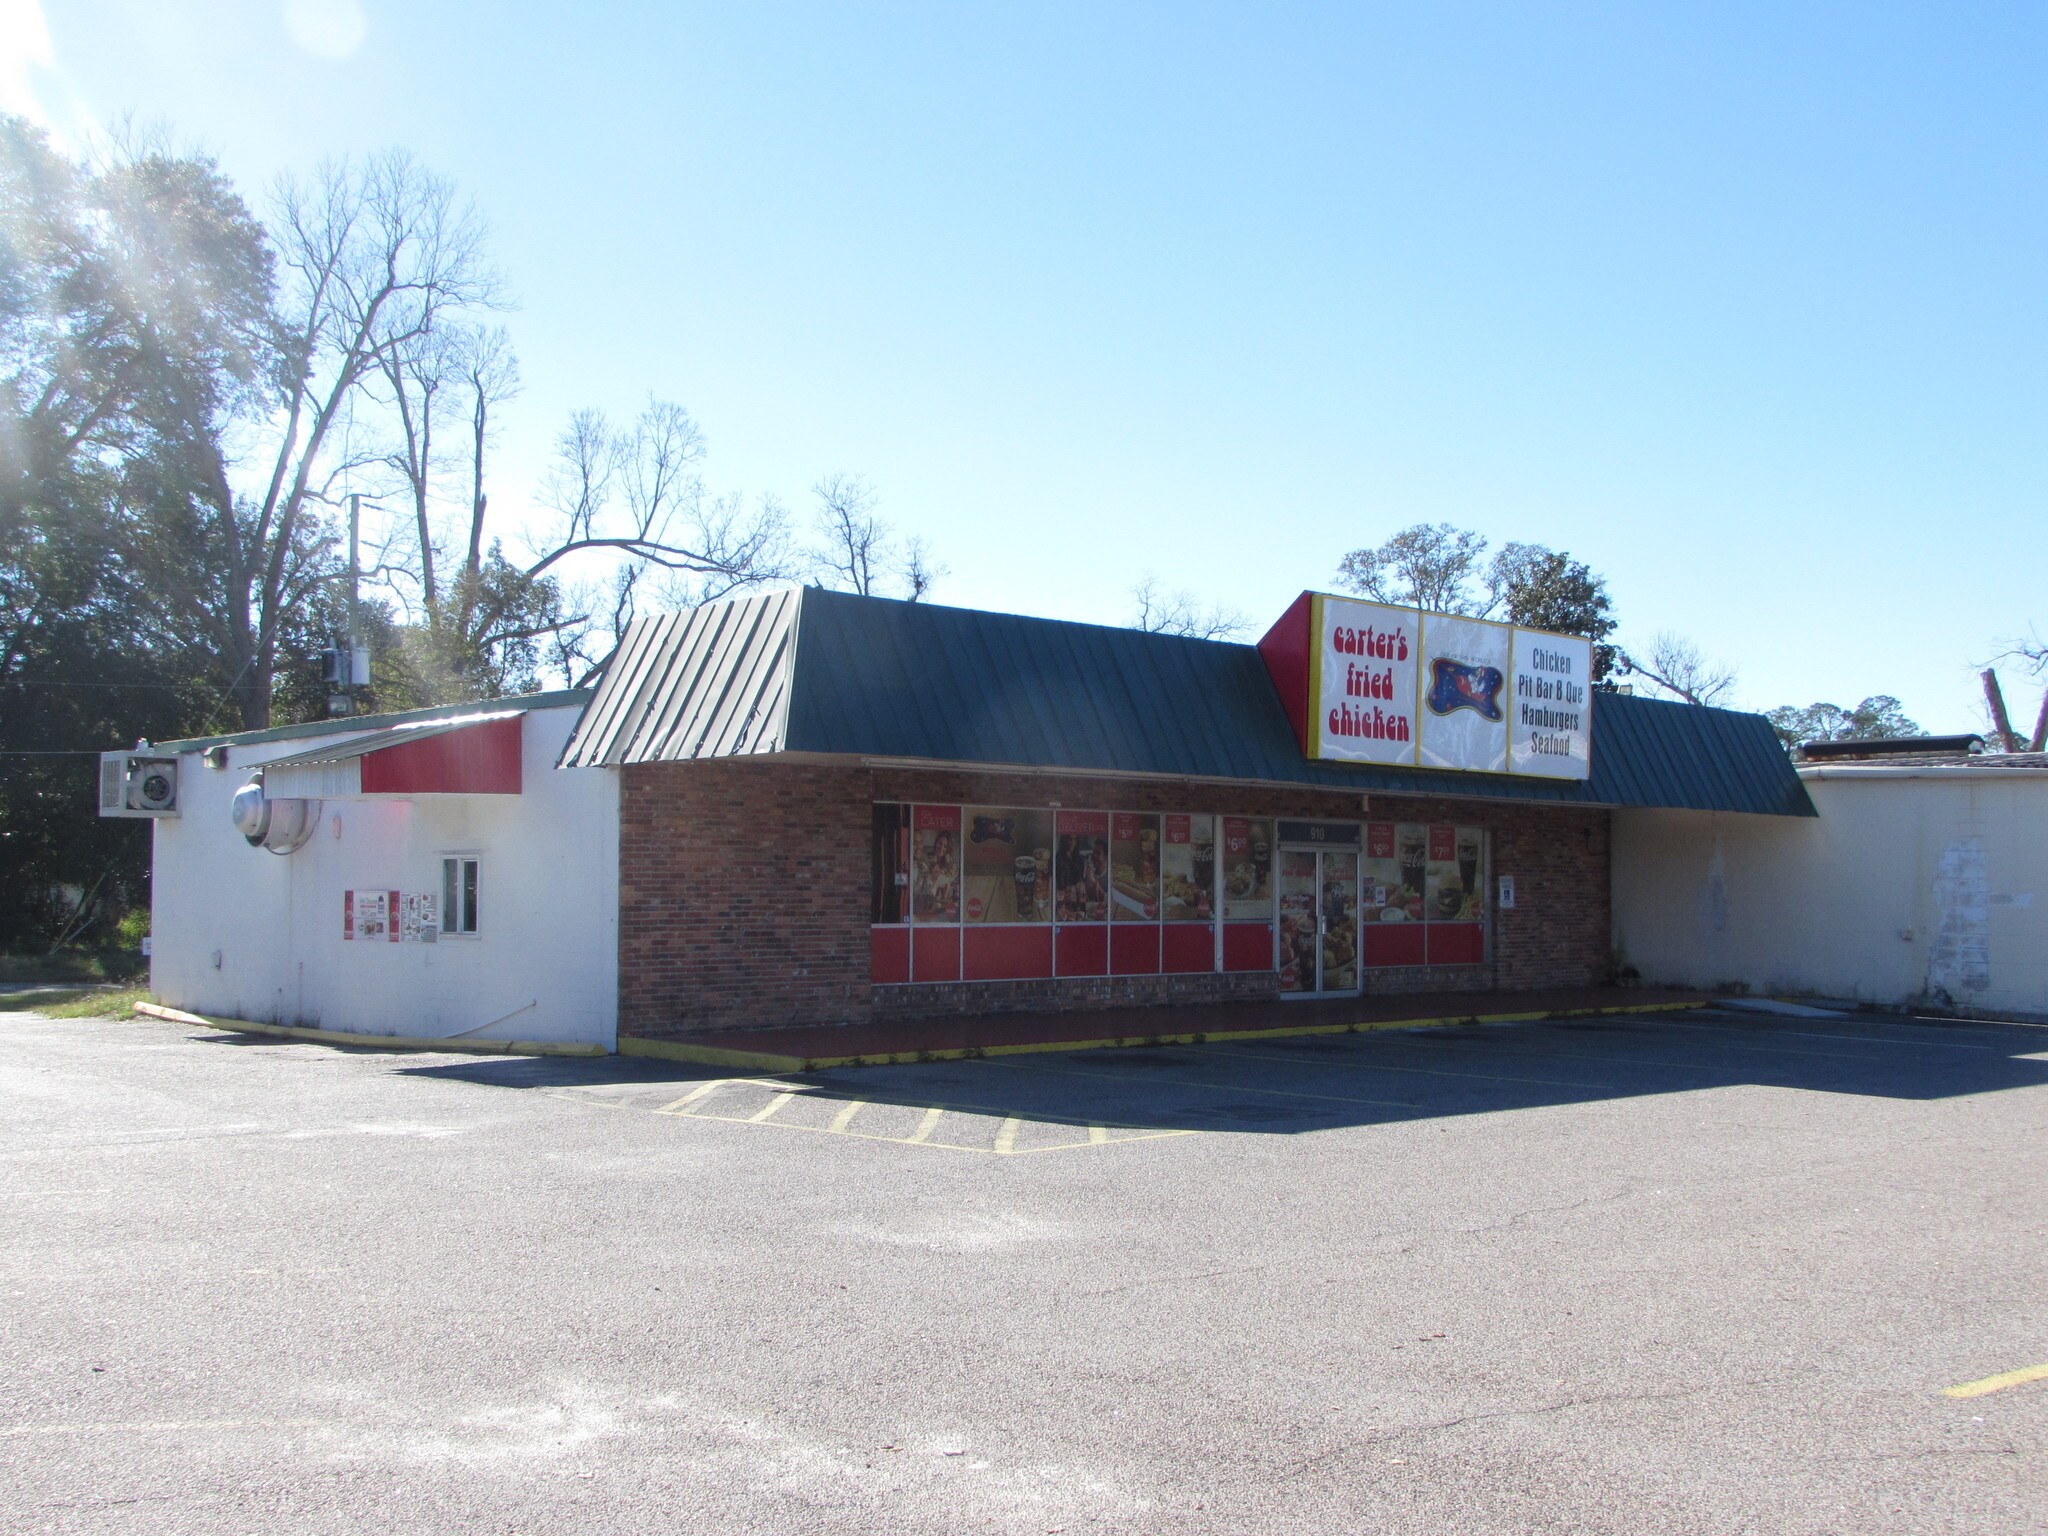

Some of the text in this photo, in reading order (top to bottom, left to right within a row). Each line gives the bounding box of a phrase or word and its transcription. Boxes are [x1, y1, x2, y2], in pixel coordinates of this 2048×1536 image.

[1532, 648, 1571, 674] Chicken
[1346, 662, 1393, 700] fried
[1518, 674, 1583, 704] Pit Bar B Que
[1329, 702, 1409, 742] chicken
[1522, 703, 1578, 731] Hamburgers
[1531, 731, 1570, 756] Seafood
[920, 816, 953, 828] CATER
[1310, 827, 1325, 840] 910
